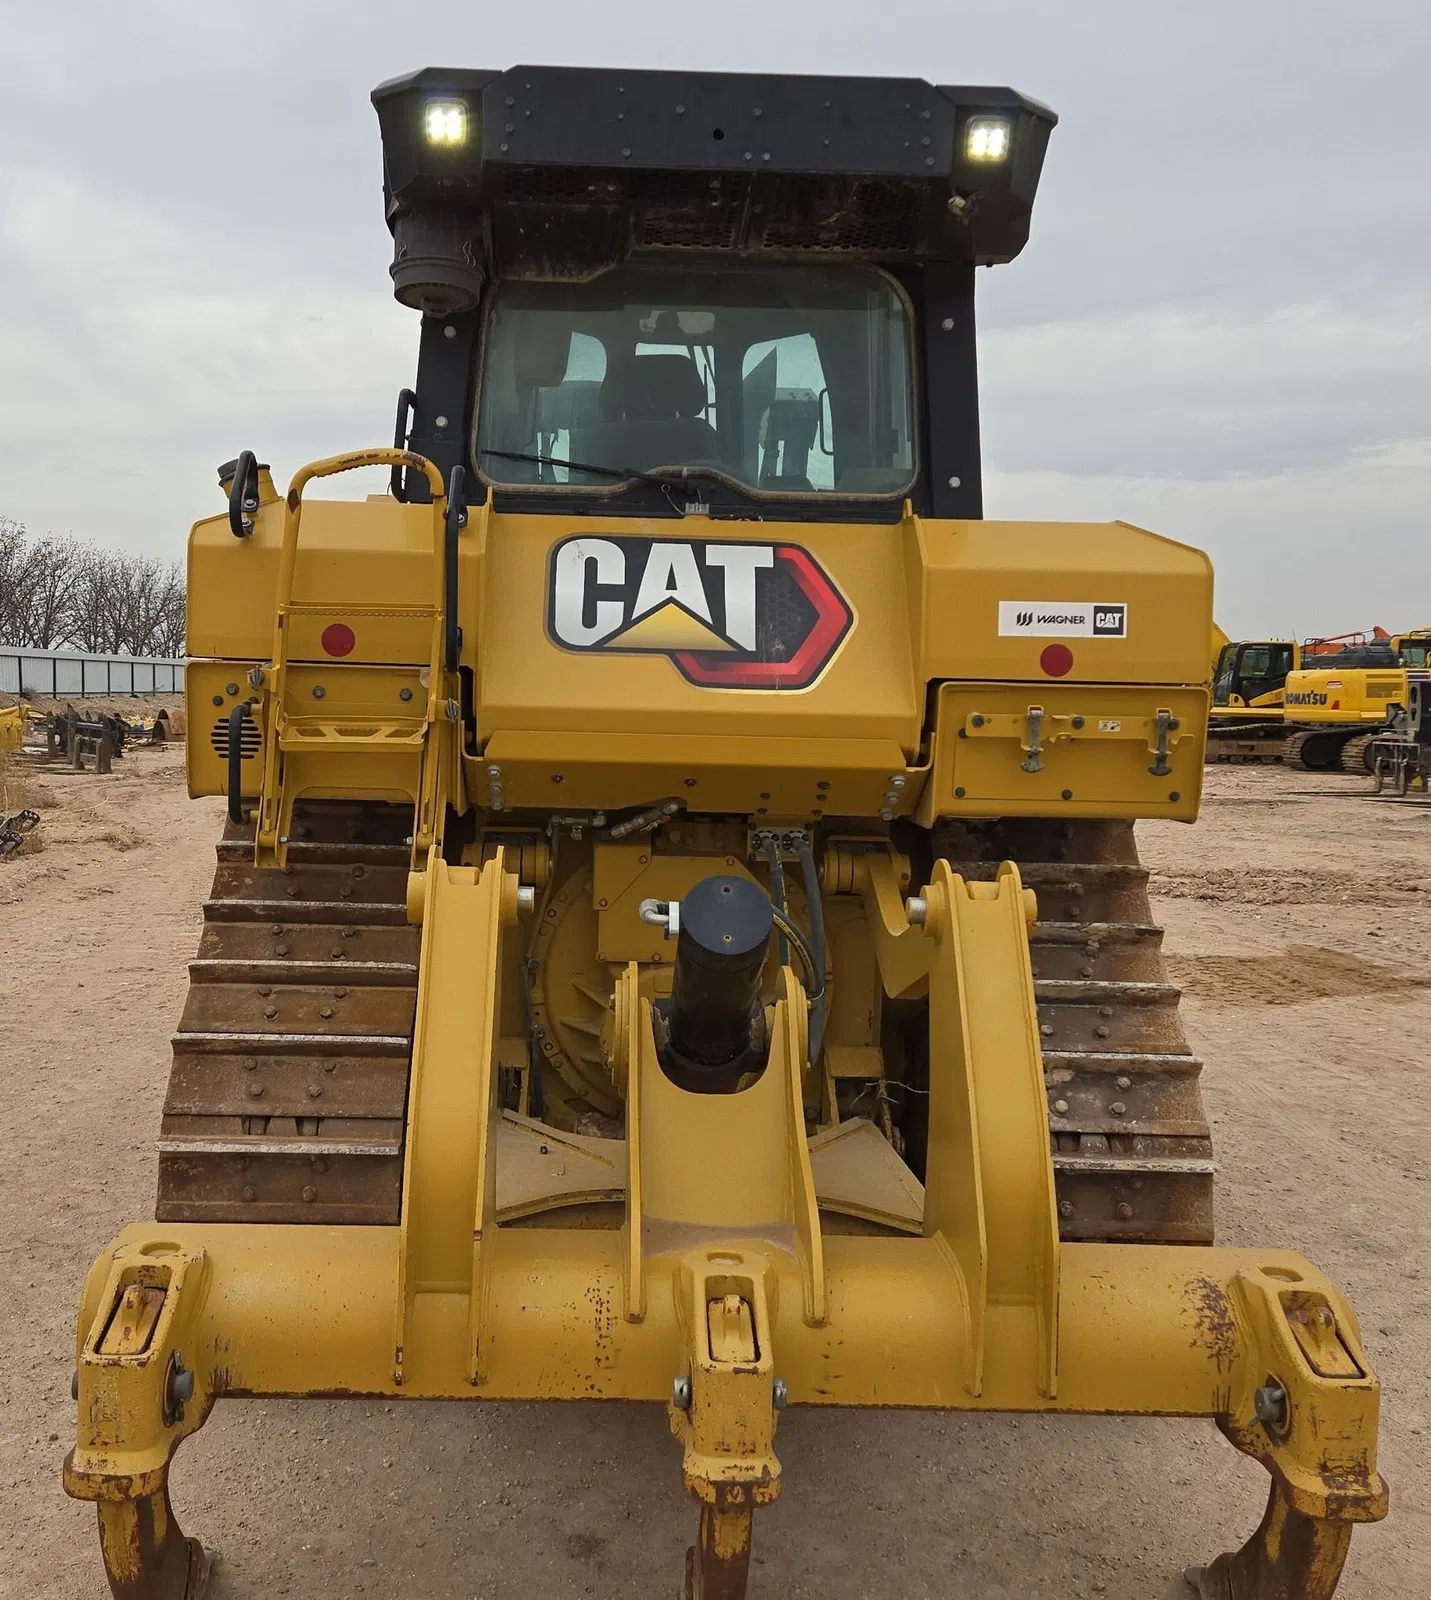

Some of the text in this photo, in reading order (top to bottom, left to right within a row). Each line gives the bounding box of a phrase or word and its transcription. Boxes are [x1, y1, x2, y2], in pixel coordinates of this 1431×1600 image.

[554, 538, 774, 652] CAT
[1036, 612, 1124, 628] WAGNER CAT
